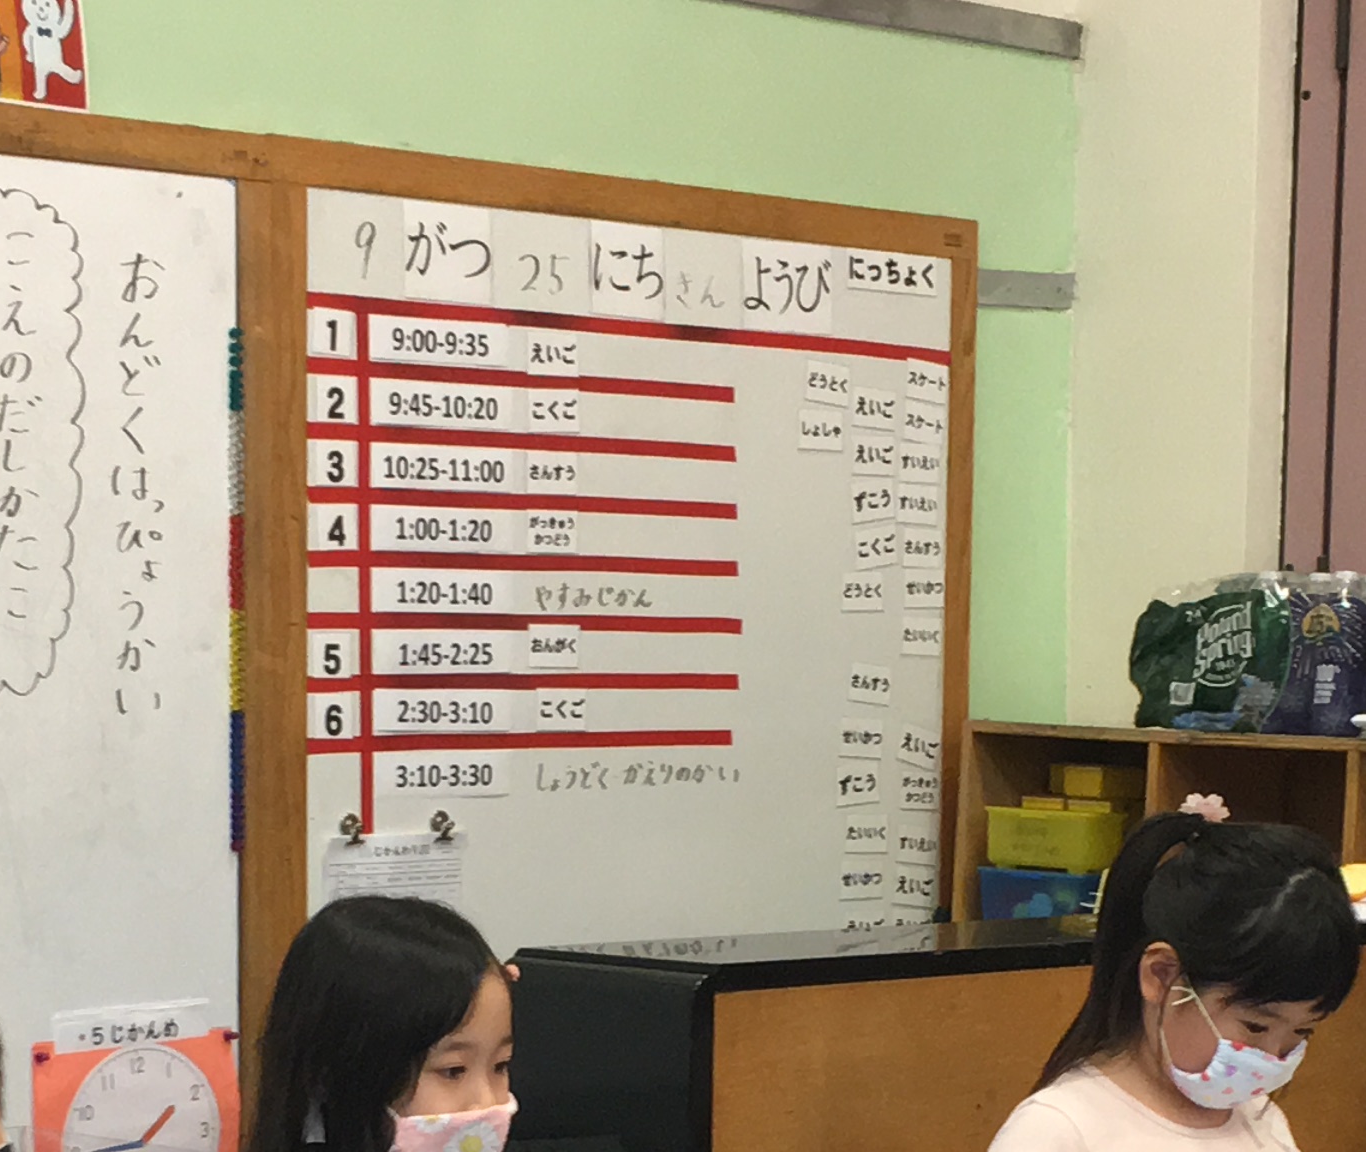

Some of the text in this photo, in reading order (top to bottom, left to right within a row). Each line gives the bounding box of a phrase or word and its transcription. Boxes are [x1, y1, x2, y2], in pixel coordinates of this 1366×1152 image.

[355, 221, 377, 279] 9
[405, 221, 492, 278] がつ
[519, 254, 570, 295] 25
[593, 244, 664, 299] にち
[743, 256, 832, 315] ようび
[849, 256, 934, 288] にっちょく
[327, 320, 489, 357] 1 9:00-9:35
[530, 343, 576, 364] えいご
[327, 387, 498, 420] 2 9:45-10:20
[532, 400, 577, 420] こくご
[855, 396, 895, 418] えいご
[855, 444, 894, 464] えいご
[327, 450, 504, 483] 3 10:25-11:00
[529, 464, 576, 481] さんすう
[110, 252, 166, 715] おんどくはっぴょうかい
[328, 515, 492, 546] 4 1:00-1:20
[858, 534, 895, 557] こくご
[397, 581, 492, 605] 1:20-1:40
[324, 643, 493, 675] 5 1:45-2:25
[851, 674, 890, 692] さんすう
[325, 700, 493, 736] 6 2:30-3:10
[540, 699, 586, 719] こくご
[901, 732, 939, 759] えいご
[396, 764, 492, 787] 3:10-3:30
[896, 875, 933, 896] えいご
[130, 1056, 145, 1074] 12
[165, 1061, 172, 1078] 1
[101, 1074, 116, 1091] 11
[189, 1084, 202, 1101] 2
[74, 1105, 95, 1121] 10
[200, 1122, 210, 1138] 3
